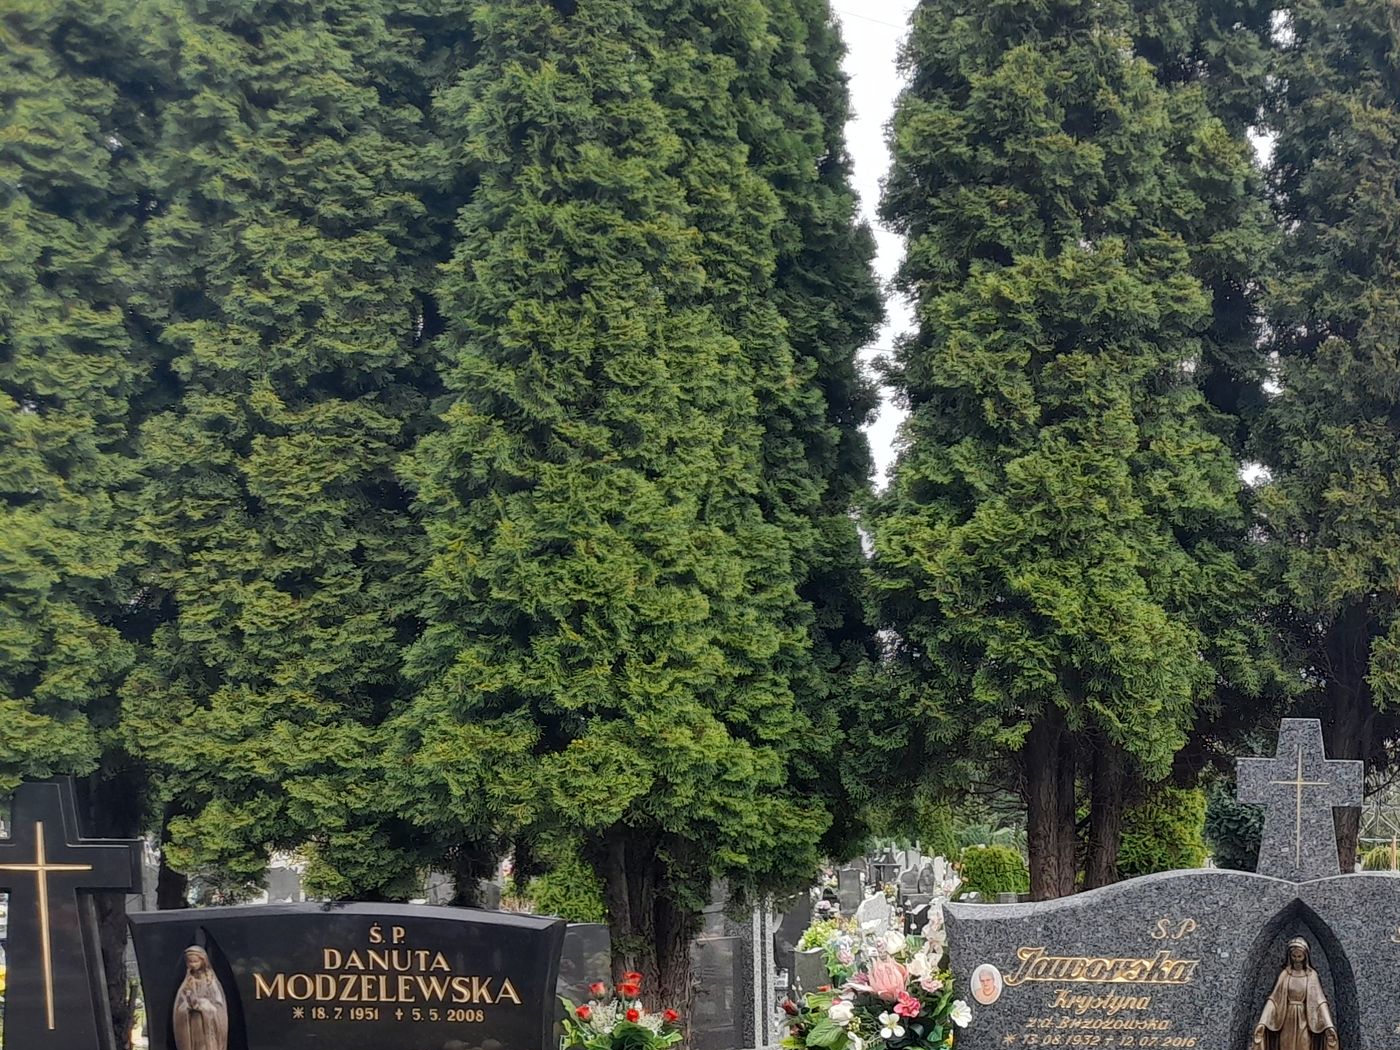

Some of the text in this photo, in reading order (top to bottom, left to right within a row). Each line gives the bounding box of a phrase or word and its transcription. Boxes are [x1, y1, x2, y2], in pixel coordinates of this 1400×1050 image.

[323, 948, 451, 971] DANUTA
[1003, 946, 1200, 986] Jaworska
[253, 972, 521, 1004] MODZELEWSKA
[1048, 988, 1150, 1015] Krystyna
[311, 1006, 329, 1020] 18.
[350, 1007, 379, 1021] 1951
[447, 1009, 485, 1022] 2008
